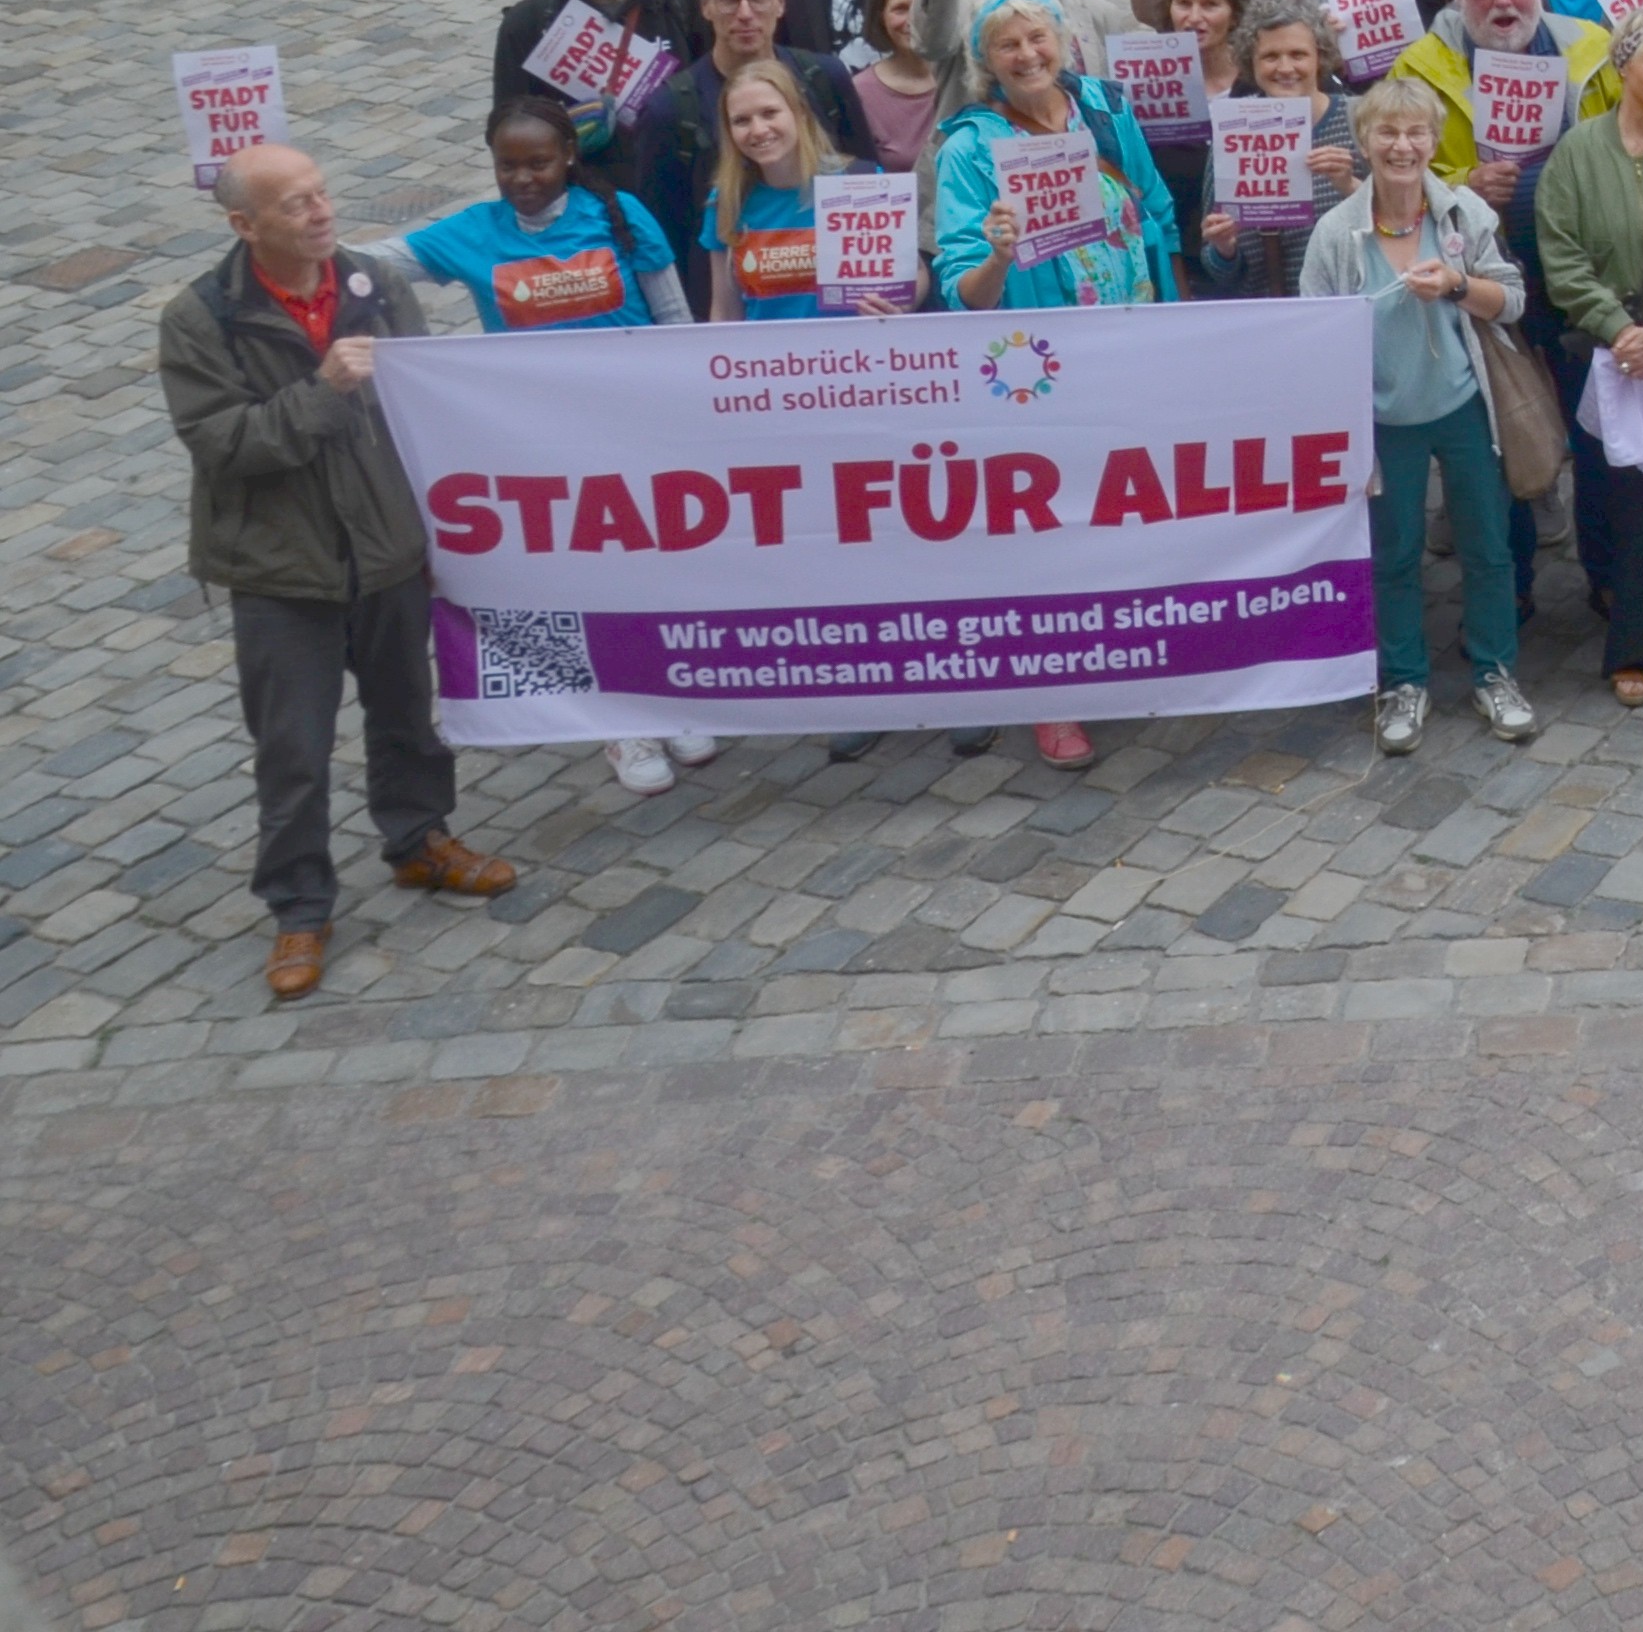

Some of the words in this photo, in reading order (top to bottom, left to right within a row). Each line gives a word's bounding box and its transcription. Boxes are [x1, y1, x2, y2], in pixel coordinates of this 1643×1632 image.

[1352, 2, 1396, 28] FÜR
[1357, 23, 1405, 50] ALLE
[549, 16, 605, 87] STADT
[189, 85, 269, 110] STADT
[1478, 75, 1558, 100] STADT
[209, 108, 260, 133] FÜR
[1491, 100, 1543, 123] FÜR
[1224, 133, 1300, 153] STADT
[1486, 124, 1543, 146] ALLE
[1239, 153, 1287, 175] FÜR
[1007, 166, 1085, 193] STADT
[1235, 179, 1289, 197] ALLE
[1025, 190, 1076, 214] FÜR
[827, 211, 905, 231] STADT
[1025, 207, 1079, 234] ALLE
[760, 244, 810, 260] TERRE
[843, 232, 892, 255] FÜR
[838, 259, 894, 279] ALLE
[709, 347, 959, 380] Osnabrück-bunt
[713, 388, 772, 414] und
[782, 379, 961, 410] solidarisch!
[427, 465, 802, 555] STADT
[831, 439, 1063, 543] FÜR
[1090, 431, 1349, 527] ALLE
[660, 622, 726, 651] Wir
[736, 615, 867, 648] wollen
[878, 611, 948, 643] alle
[958, 608, 1020, 647] gut
[1032, 601, 1104, 634] und
[1114, 594, 1228, 630] sicher
[1236, 578, 1347, 621] leben.
[667, 655, 894, 687] Gemeinsam
[903, 650, 1000, 684] aktiv
[1009, 639, 1169, 678] werden!
